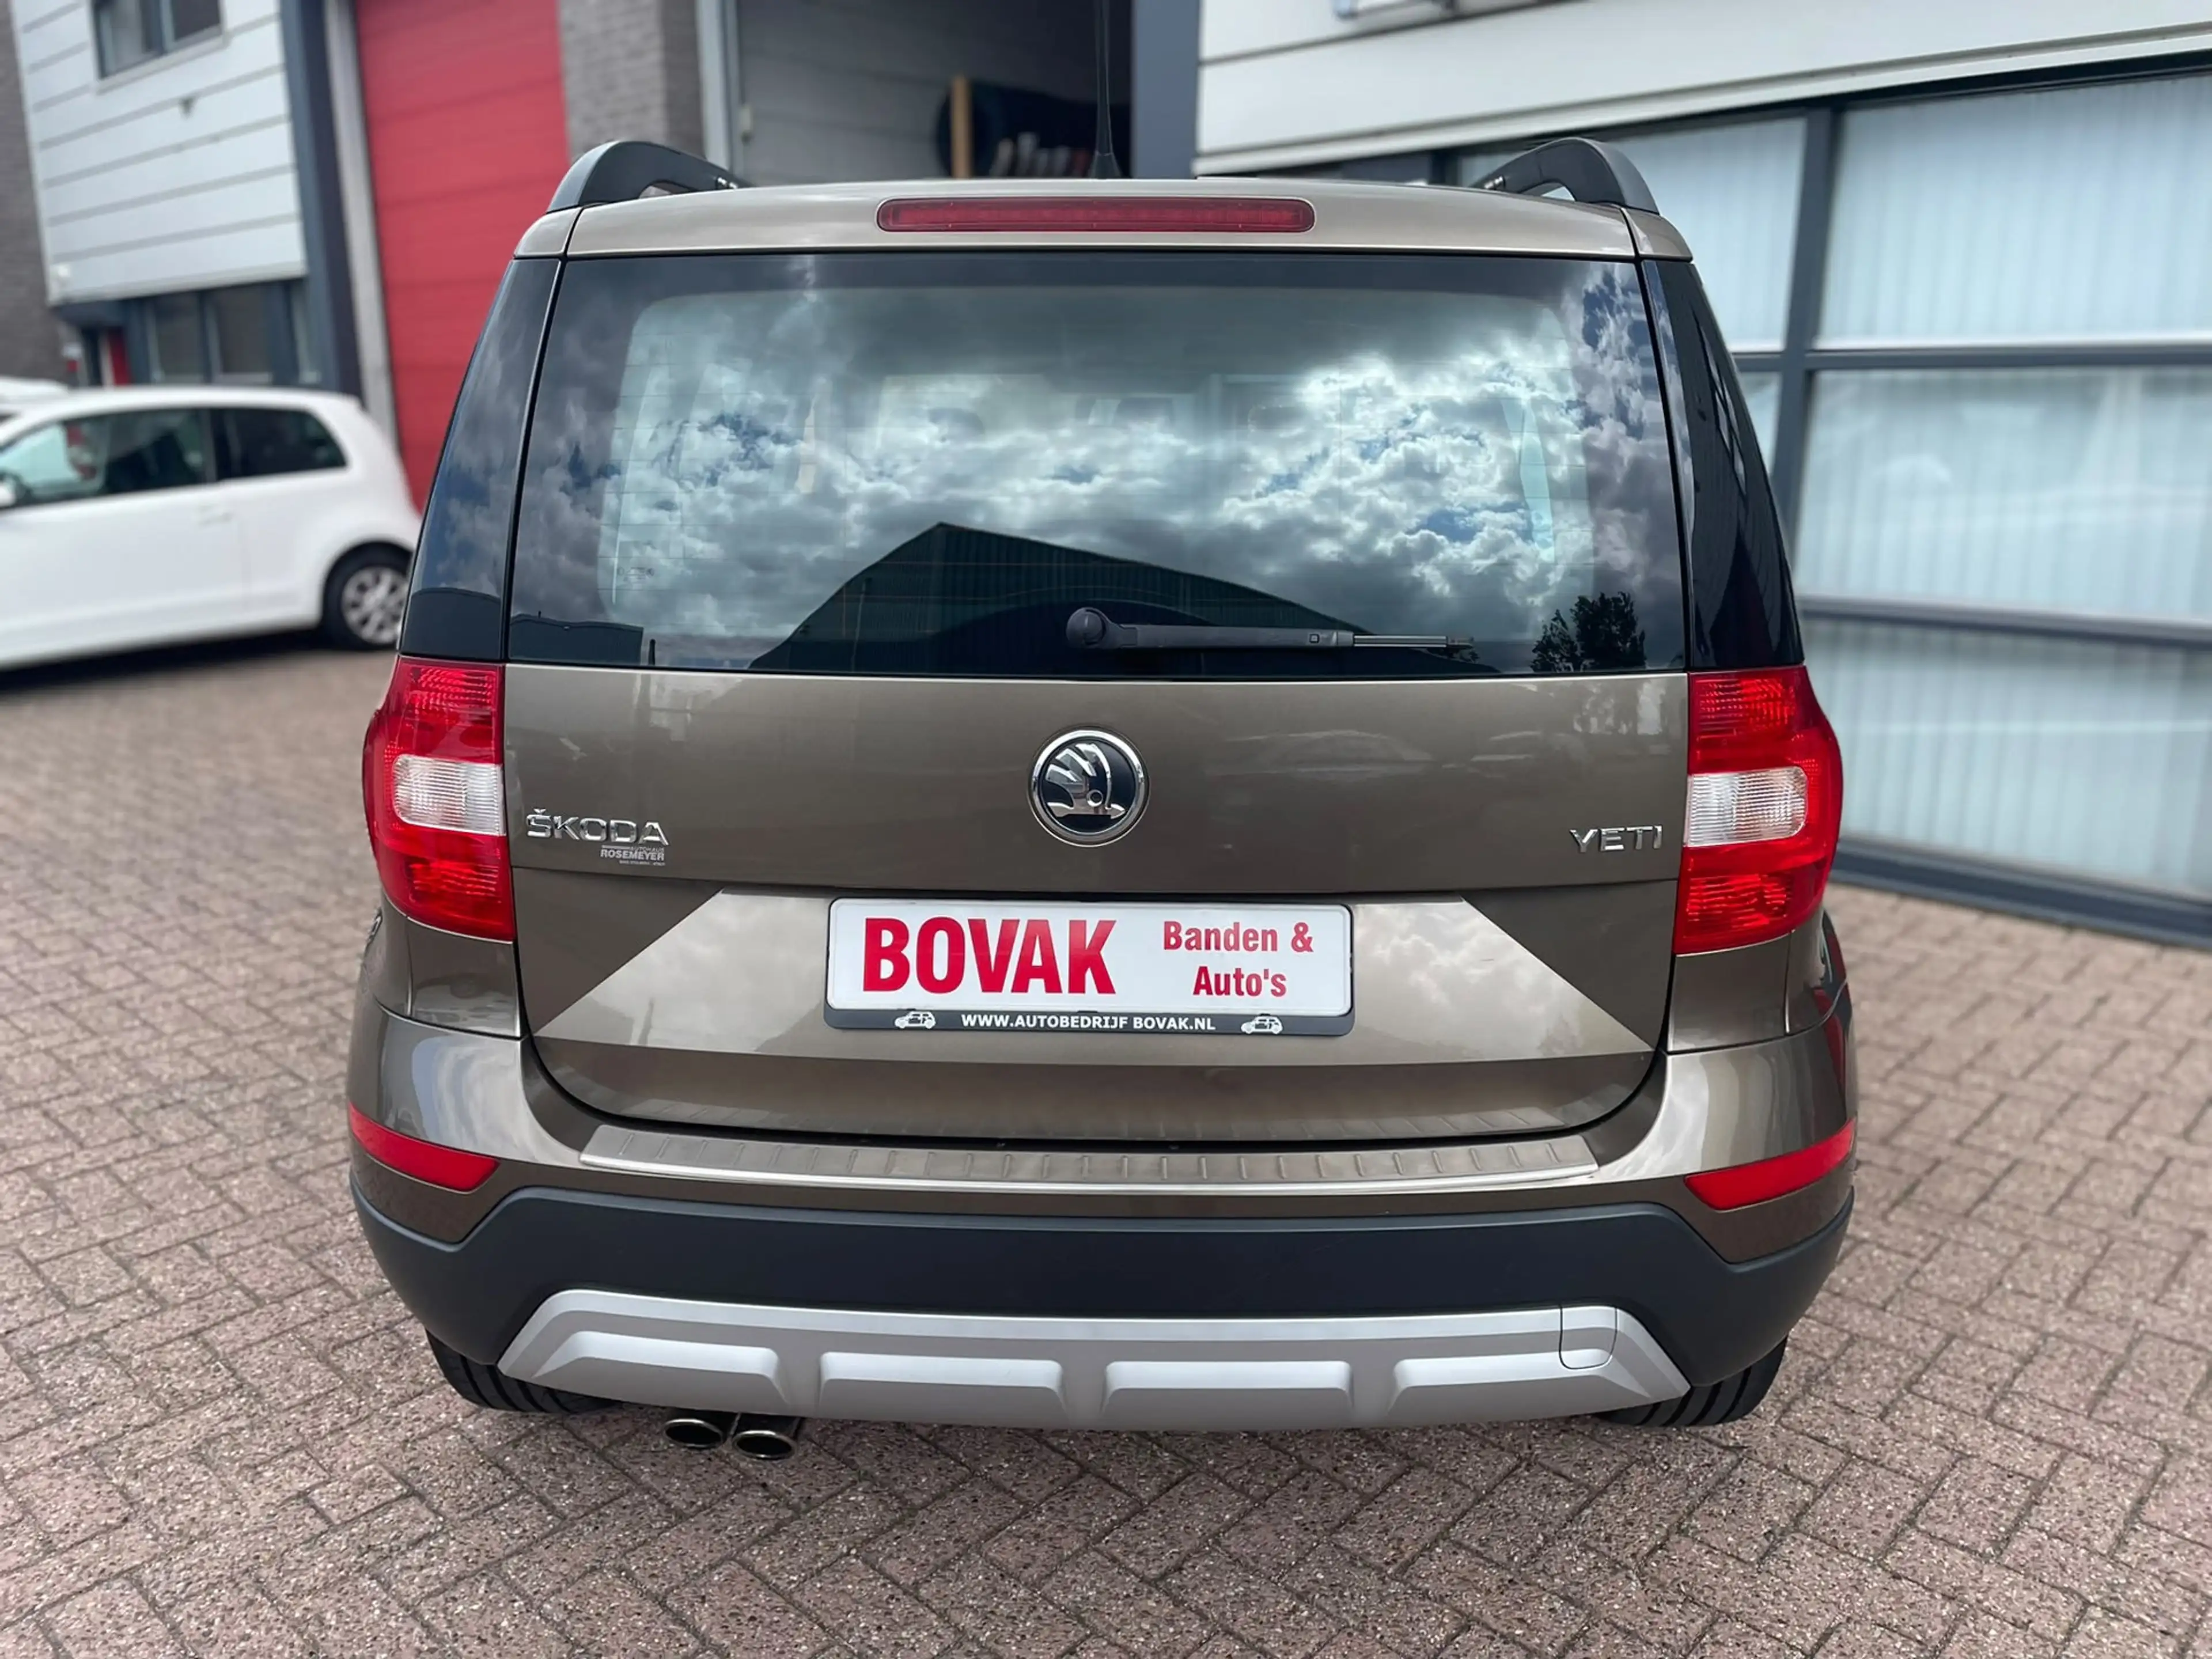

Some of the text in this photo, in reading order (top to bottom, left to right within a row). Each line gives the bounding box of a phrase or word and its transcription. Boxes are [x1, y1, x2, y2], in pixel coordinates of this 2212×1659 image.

[526, 808, 669, 846] ŠKODA
[1569, 825, 1662, 853] YETI
[600, 849, 664, 861] ROSEMEYER
[1163, 921, 1313, 952] Banden &
[863, 916, 1116, 994] BOVAK
[1192, 965, 1286, 997] Auto's
[961, 1014, 1215, 1031] WWW.AUTOBEDRIJF BOVAK.NL
